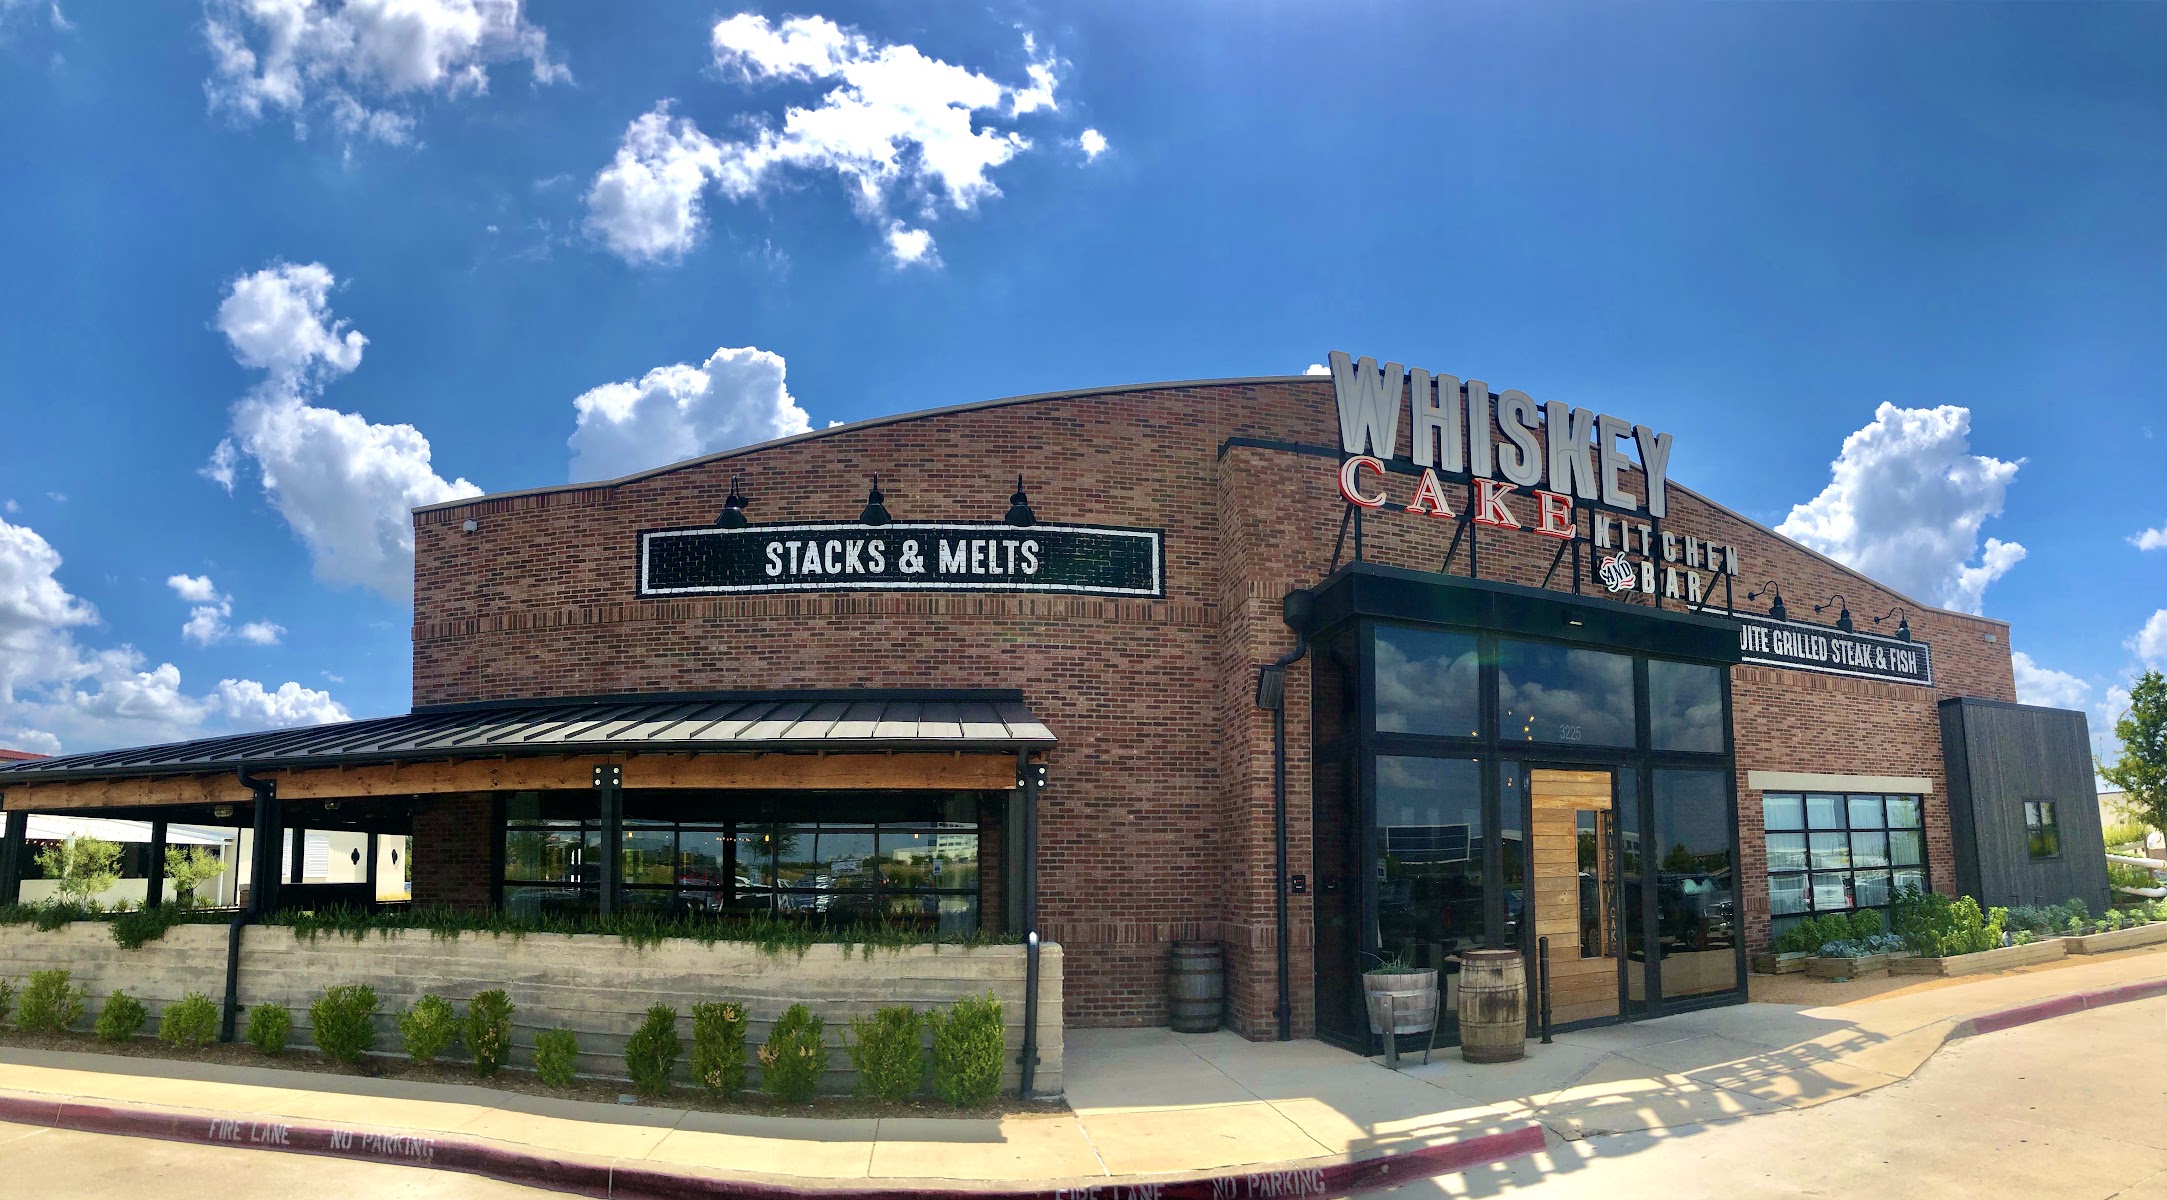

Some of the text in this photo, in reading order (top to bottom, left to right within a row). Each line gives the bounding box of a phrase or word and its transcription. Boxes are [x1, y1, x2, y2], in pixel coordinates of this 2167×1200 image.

[1328, 350, 1673, 519] WHISKEY
[1338, 455, 1577, 540] CAKE
[765, 538, 1040, 577] STACKS & MELTS
[1594, 513, 1738, 577] KITCHEN
[1600, 551, 1702, 603] AND BAR
[1773, 629, 1828, 662] GRILLED
[1831, 638, 1874, 669] STEAK
[1875, 646, 1887, 671] &
[1889, 647, 1918, 675] FISH
[1559, 724, 1582, 741] 3225
[209, 1119, 436, 1159] FIRE LANE NO PARKING
[1212, 1175, 1238, 1200] NO
[1247, 1167, 1326, 1200] PARKING
